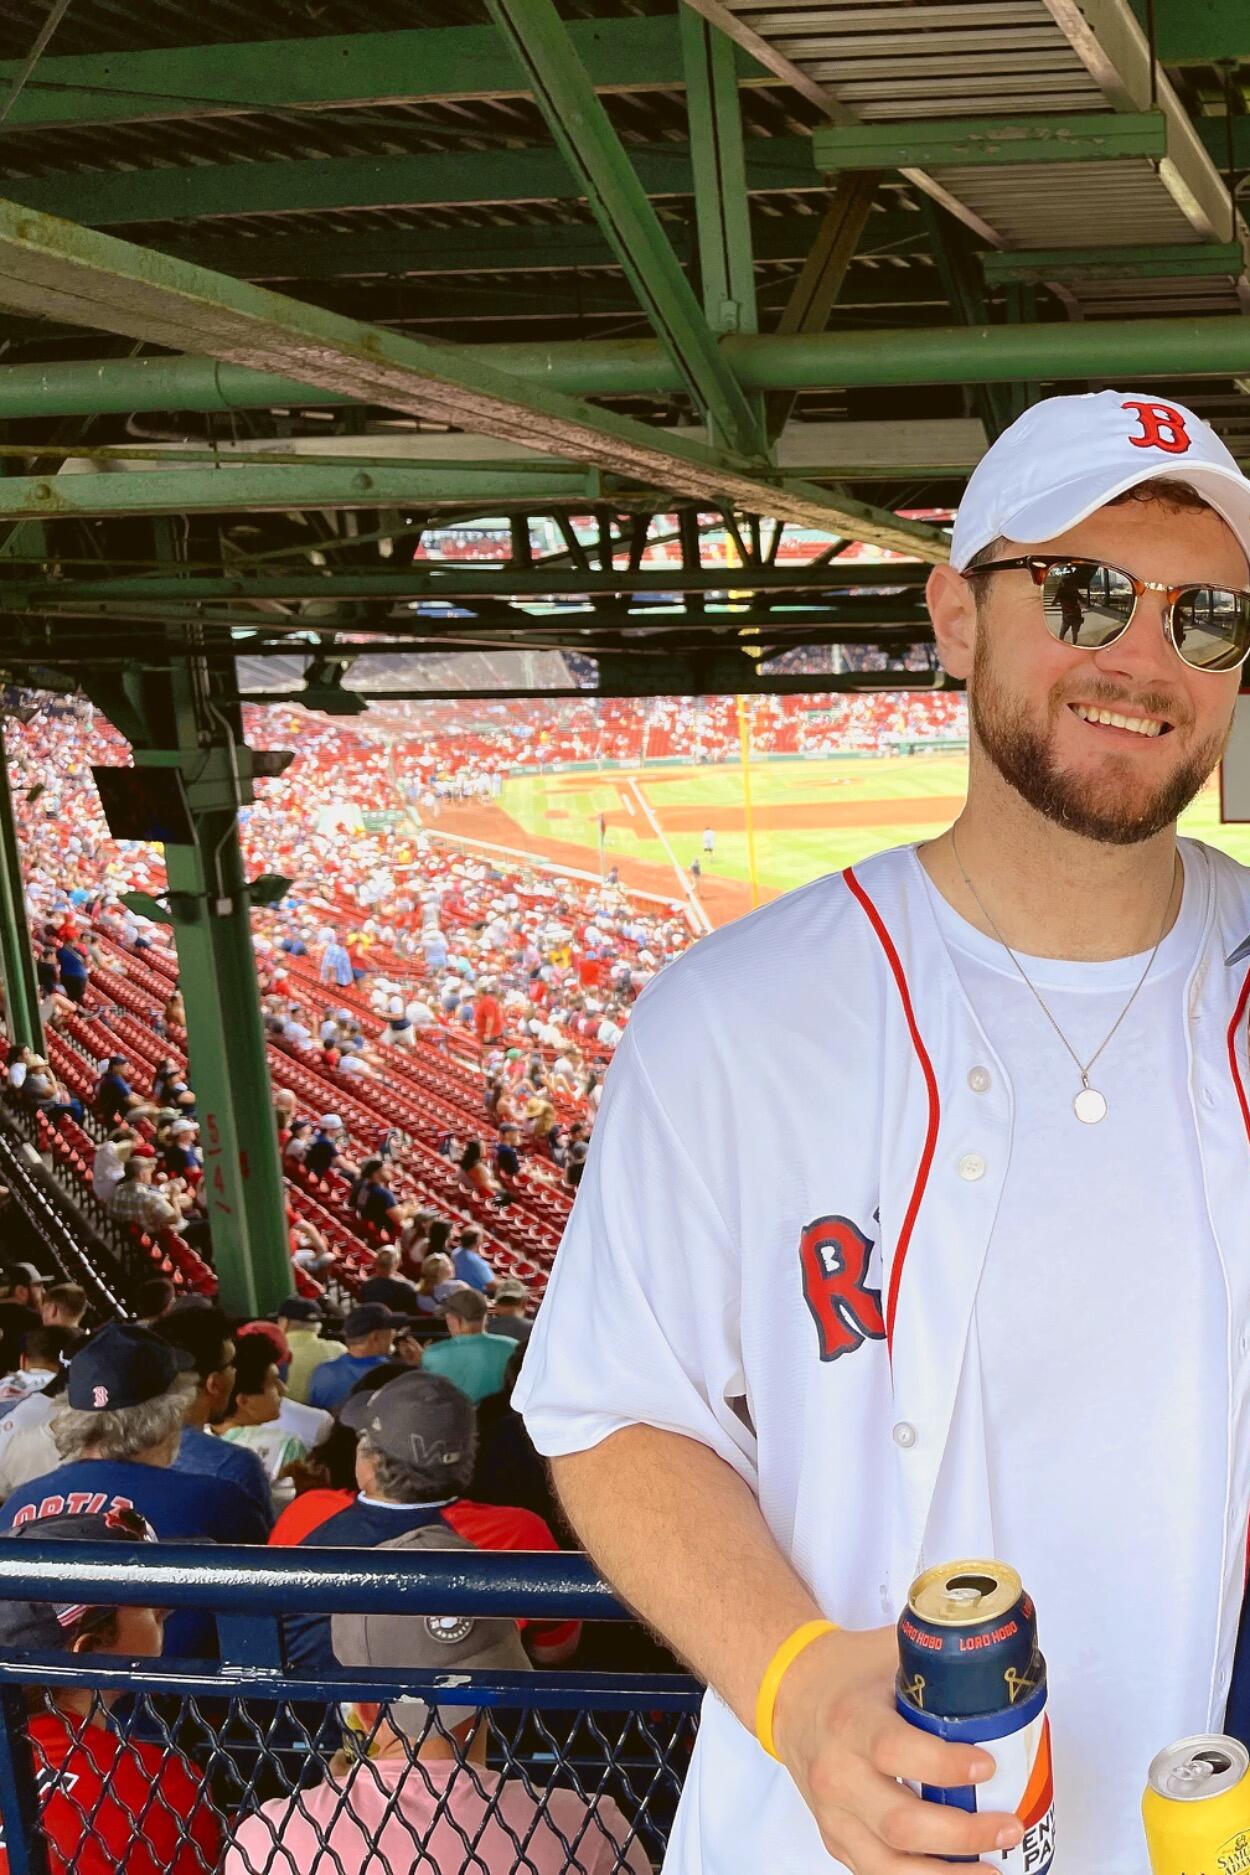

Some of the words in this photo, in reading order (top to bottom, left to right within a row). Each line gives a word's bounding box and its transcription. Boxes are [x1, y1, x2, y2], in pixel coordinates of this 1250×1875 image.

[1121, 401, 1192, 454] B
[959, 1634, 991, 1651] LORD
[991, 1620, 1018, 1642] HOBO
